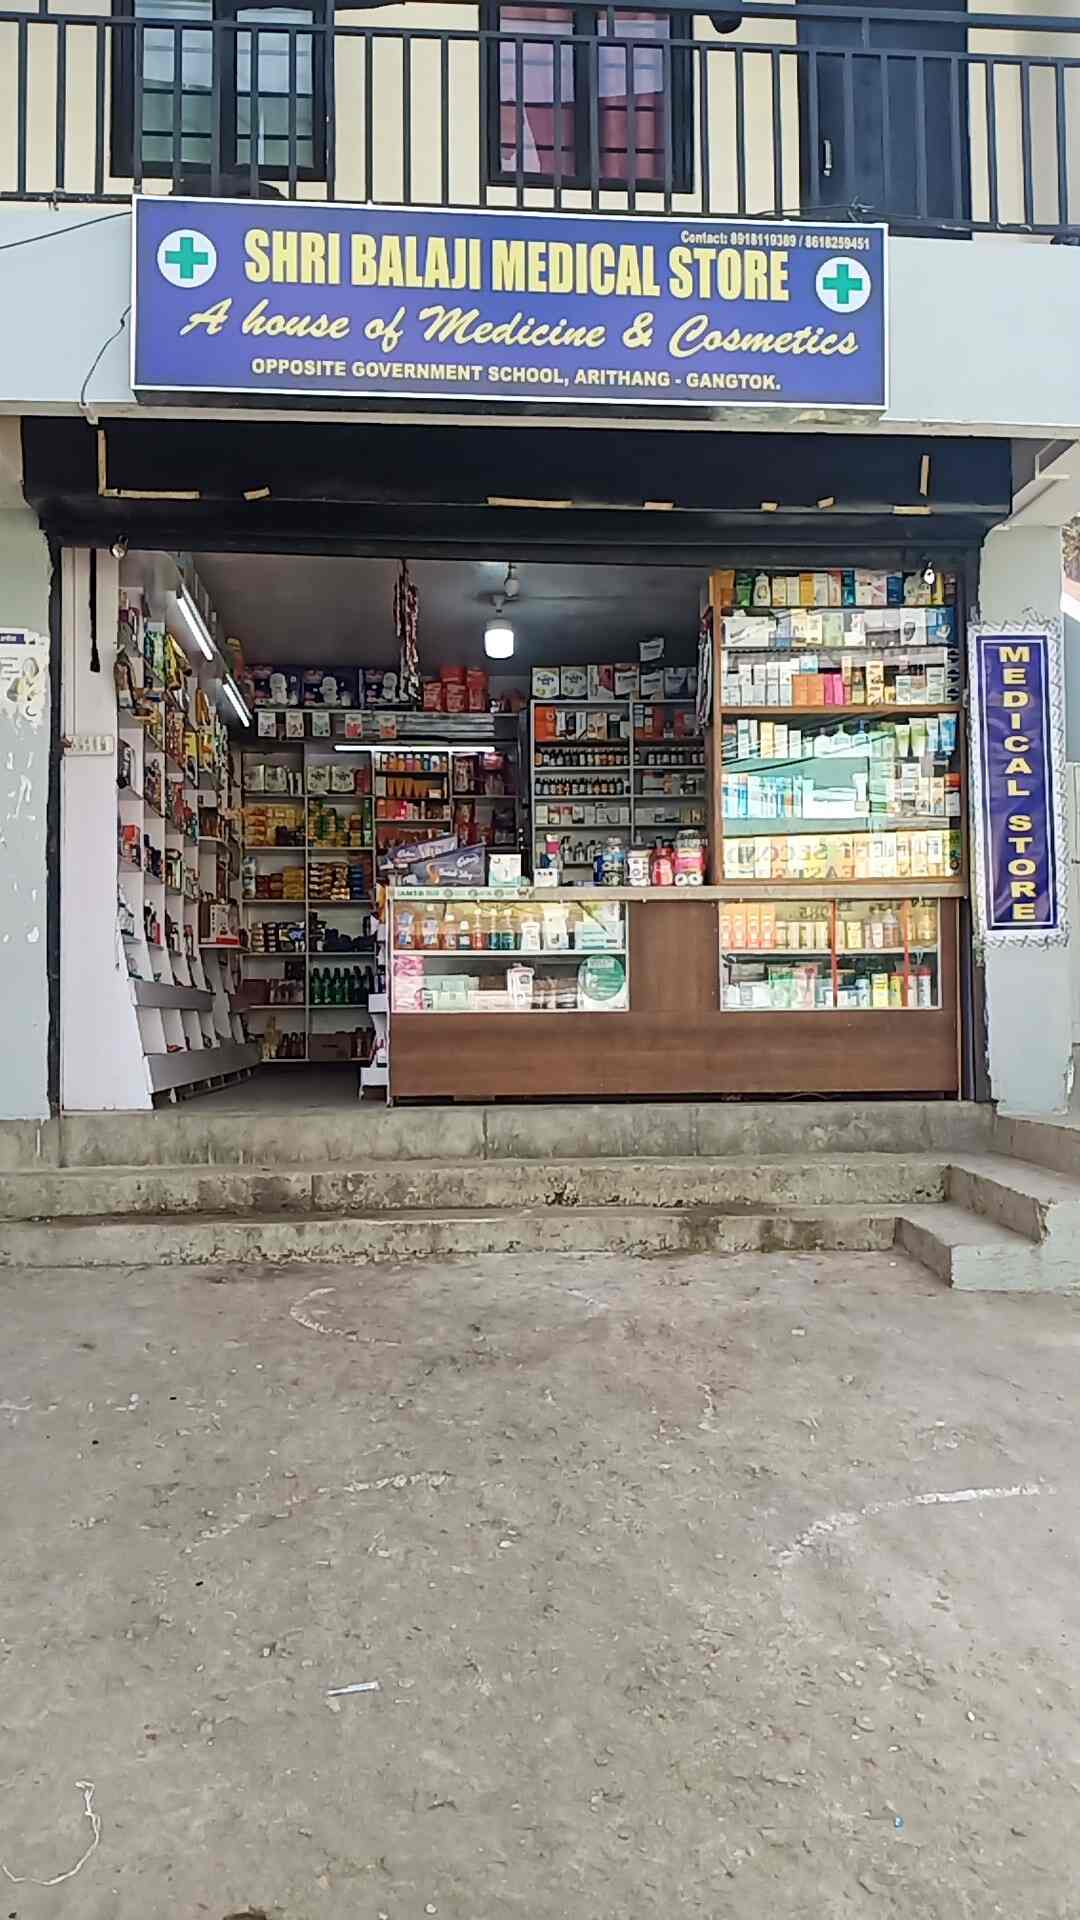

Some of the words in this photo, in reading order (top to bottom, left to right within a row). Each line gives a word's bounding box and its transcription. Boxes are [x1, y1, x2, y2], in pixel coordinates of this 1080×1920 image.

[244, 228, 341, 285] SHRI
[351, 233, 482, 290] BALAJI
[492, 239, 661, 297] MEDICAL
[669, 246, 790, 302] STORE
[681, 230, 728, 245] Contact:
[179, 297, 233, 336] A
[241, 298, 350, 339] house
[364, 306, 406, 353] of
[418, 305, 606, 348] Medicine
[622, 311, 654, 348] &
[668, 313, 859, 358] Cosmetics
[251, 358, 347, 377] OPPOSITE
[351, 361, 483, 381] GOVERNMENT
[487, 366, 570, 387] SCHOOL,
[573, 368, 671, 387] ARITHANG
[686, 372, 781, 390] GANGTOK.
[999, 646, 1032, 796] MEDICAL
[1008, 815, 1036, 920] STORE
